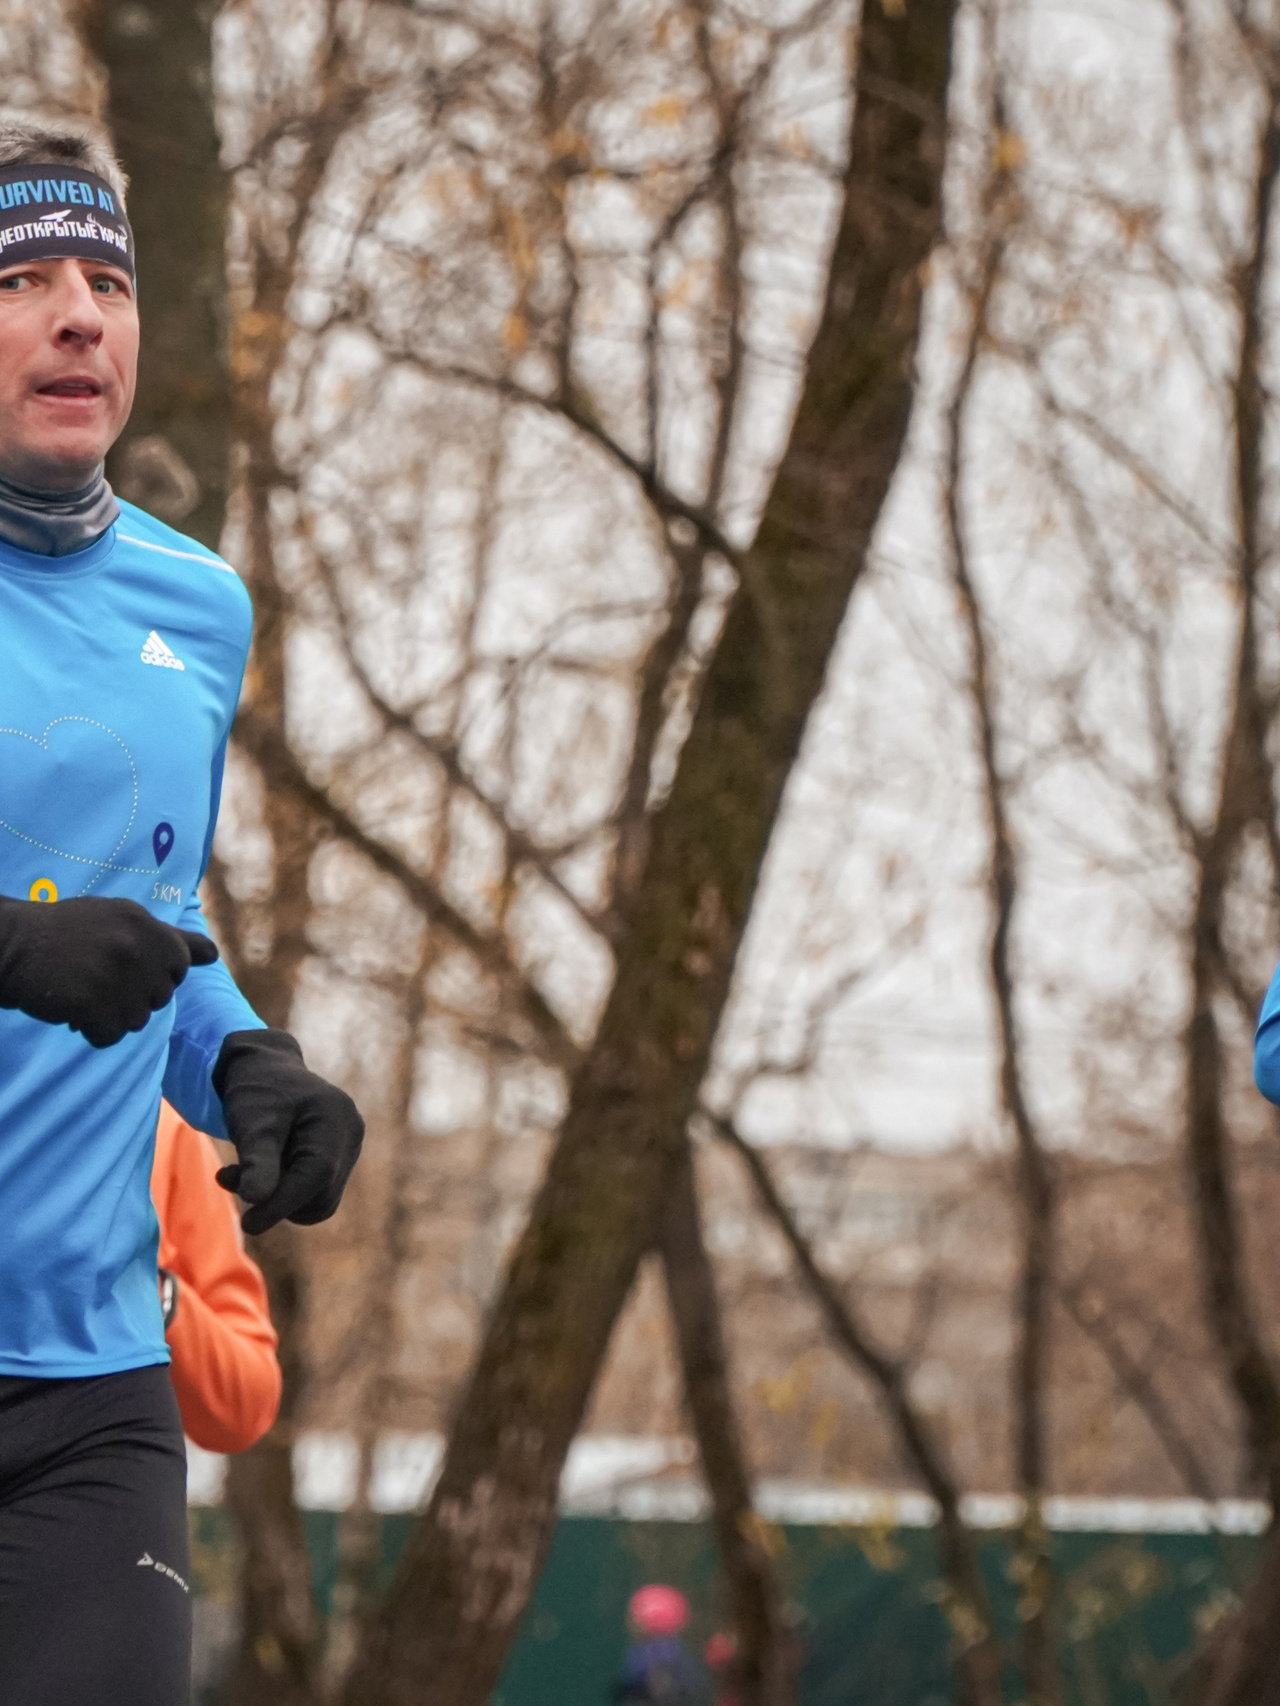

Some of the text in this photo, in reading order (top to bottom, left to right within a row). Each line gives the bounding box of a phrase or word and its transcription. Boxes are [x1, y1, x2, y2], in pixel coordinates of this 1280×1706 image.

[97, 187, 115, 215] AT
[140, 651, 185, 671] adidas
[151, 882, 181, 905] 5 KM
